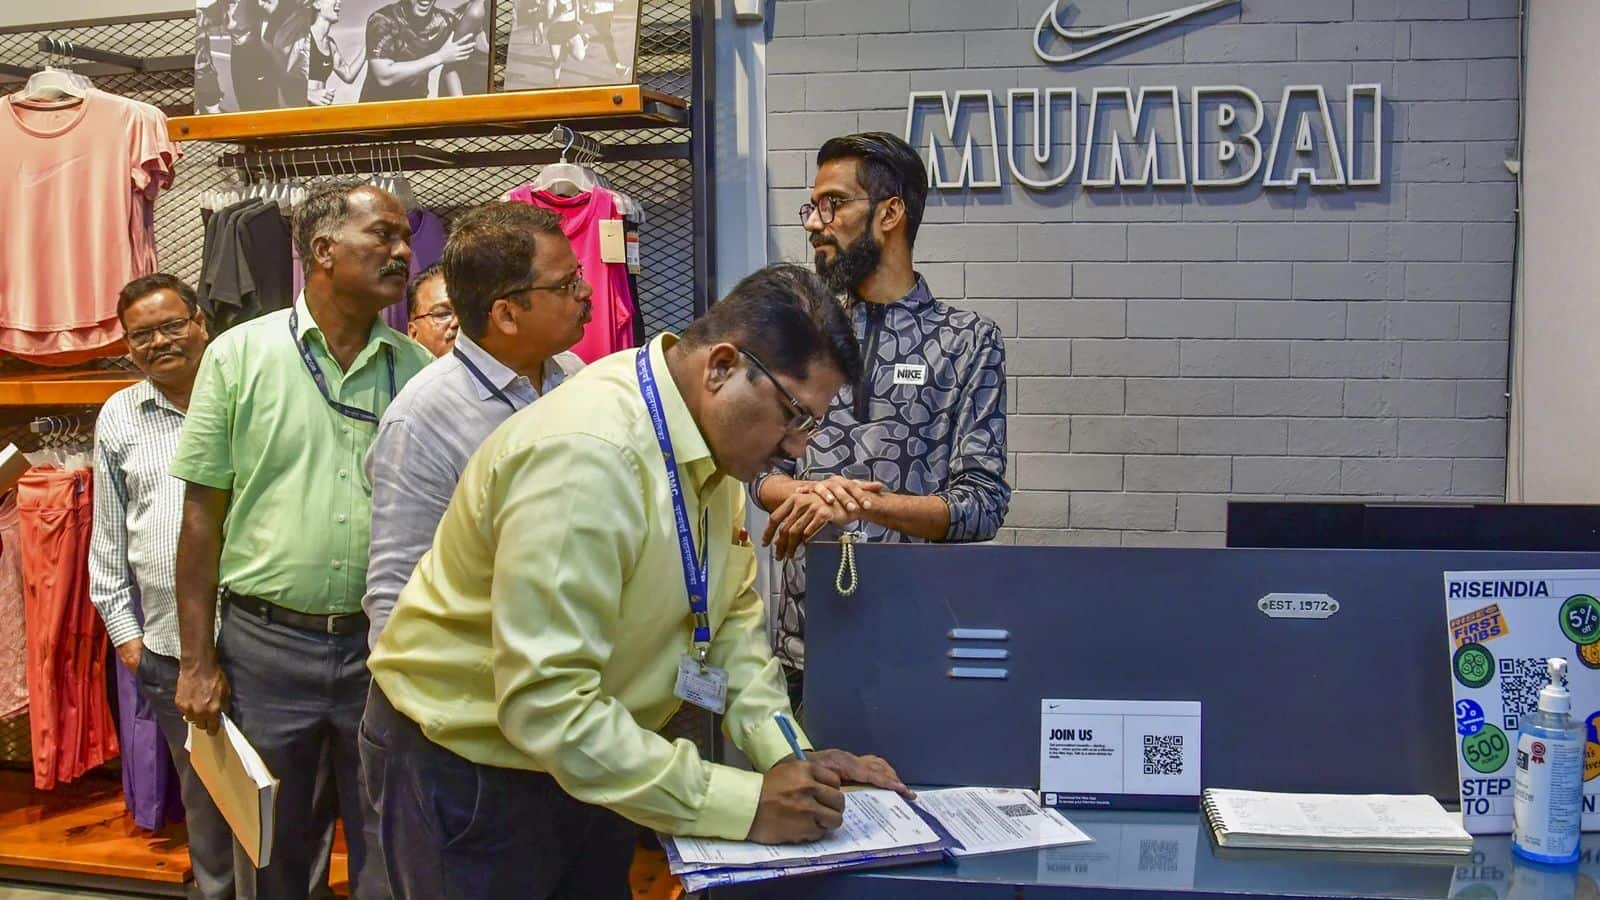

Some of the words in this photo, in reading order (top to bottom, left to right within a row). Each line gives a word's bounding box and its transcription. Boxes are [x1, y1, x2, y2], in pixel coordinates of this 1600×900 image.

[905, 84, 1382, 188] MUMBAI
[897, 368, 922, 379] NIKE
[668, 471, 679, 496] BMC
[1449, 581, 1549, 598] RISEINDIA
[1269, 600, 1296, 611] EST.
[1299, 600, 1329, 611] 1972
[1569, 605, 1598, 628] 5%
[1455, 614, 1501, 639] FIRST
[1049, 729, 1075, 741] JOIN
[1078, 729, 1093, 741] US
[1467, 734, 1504, 763] 500
[1462, 778, 1511, 796] STEP
[1463, 798, 1490, 815] TO
